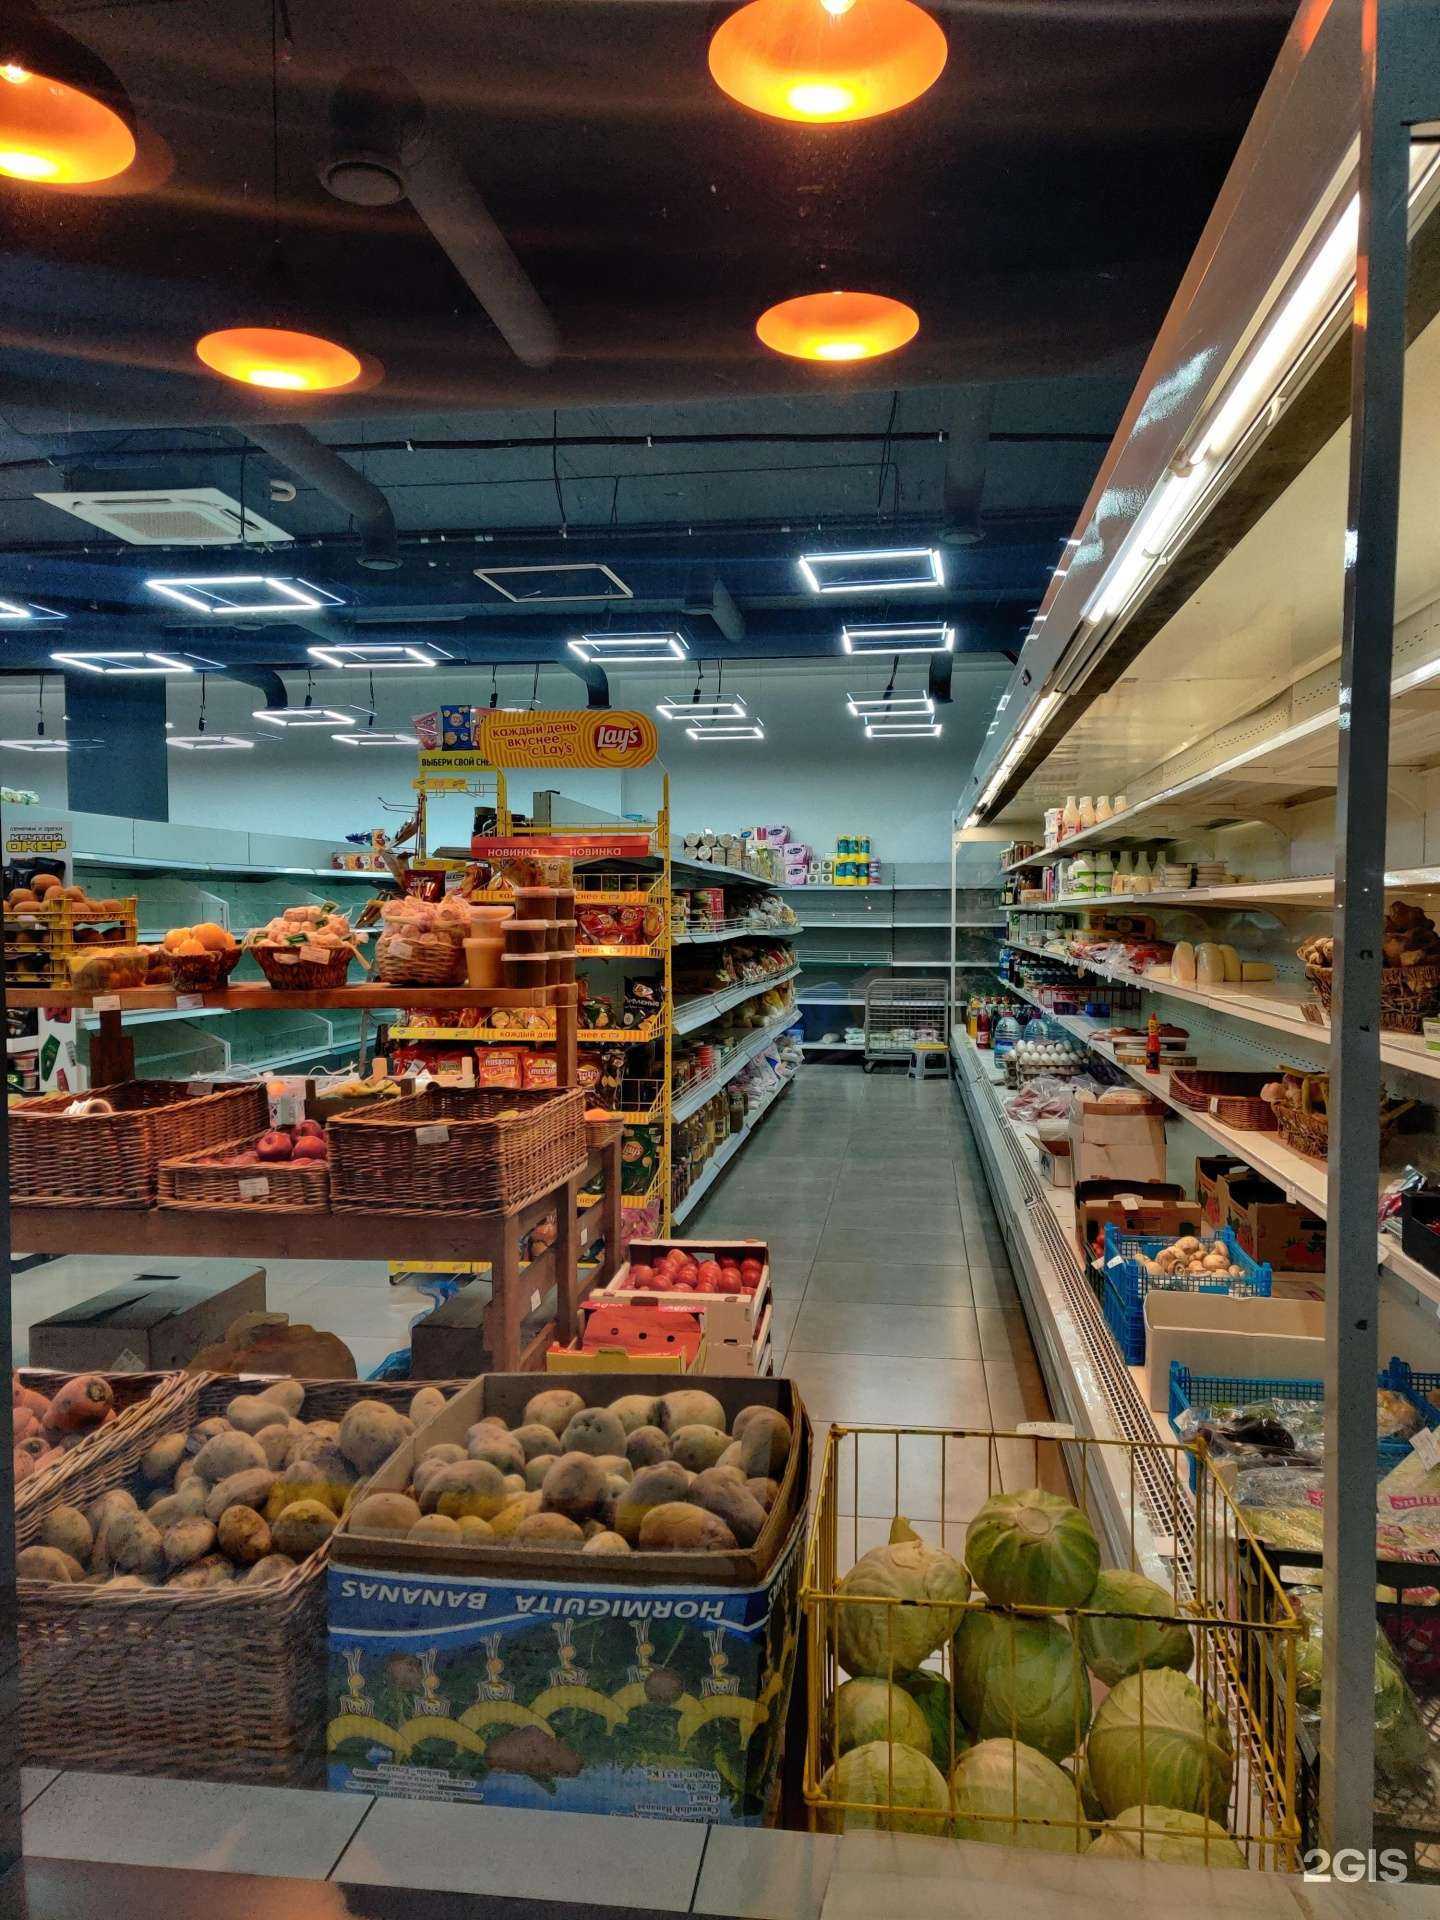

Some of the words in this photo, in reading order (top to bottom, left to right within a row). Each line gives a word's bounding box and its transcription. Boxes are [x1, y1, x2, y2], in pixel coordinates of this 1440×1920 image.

[547, 722, 578, 735] день
[508, 735, 560, 747] вкуснее
[597, 726, 639, 754] Lay's
[421, 758, 452, 767] ВЫБЕРИ
[454, 756, 475, 767] СВОЙ
[476, 758, 492, 767] СНЕ
[341, 1579, 488, 1611] BANANAS
[515, 1593, 724, 1620] HORMIGUITA
